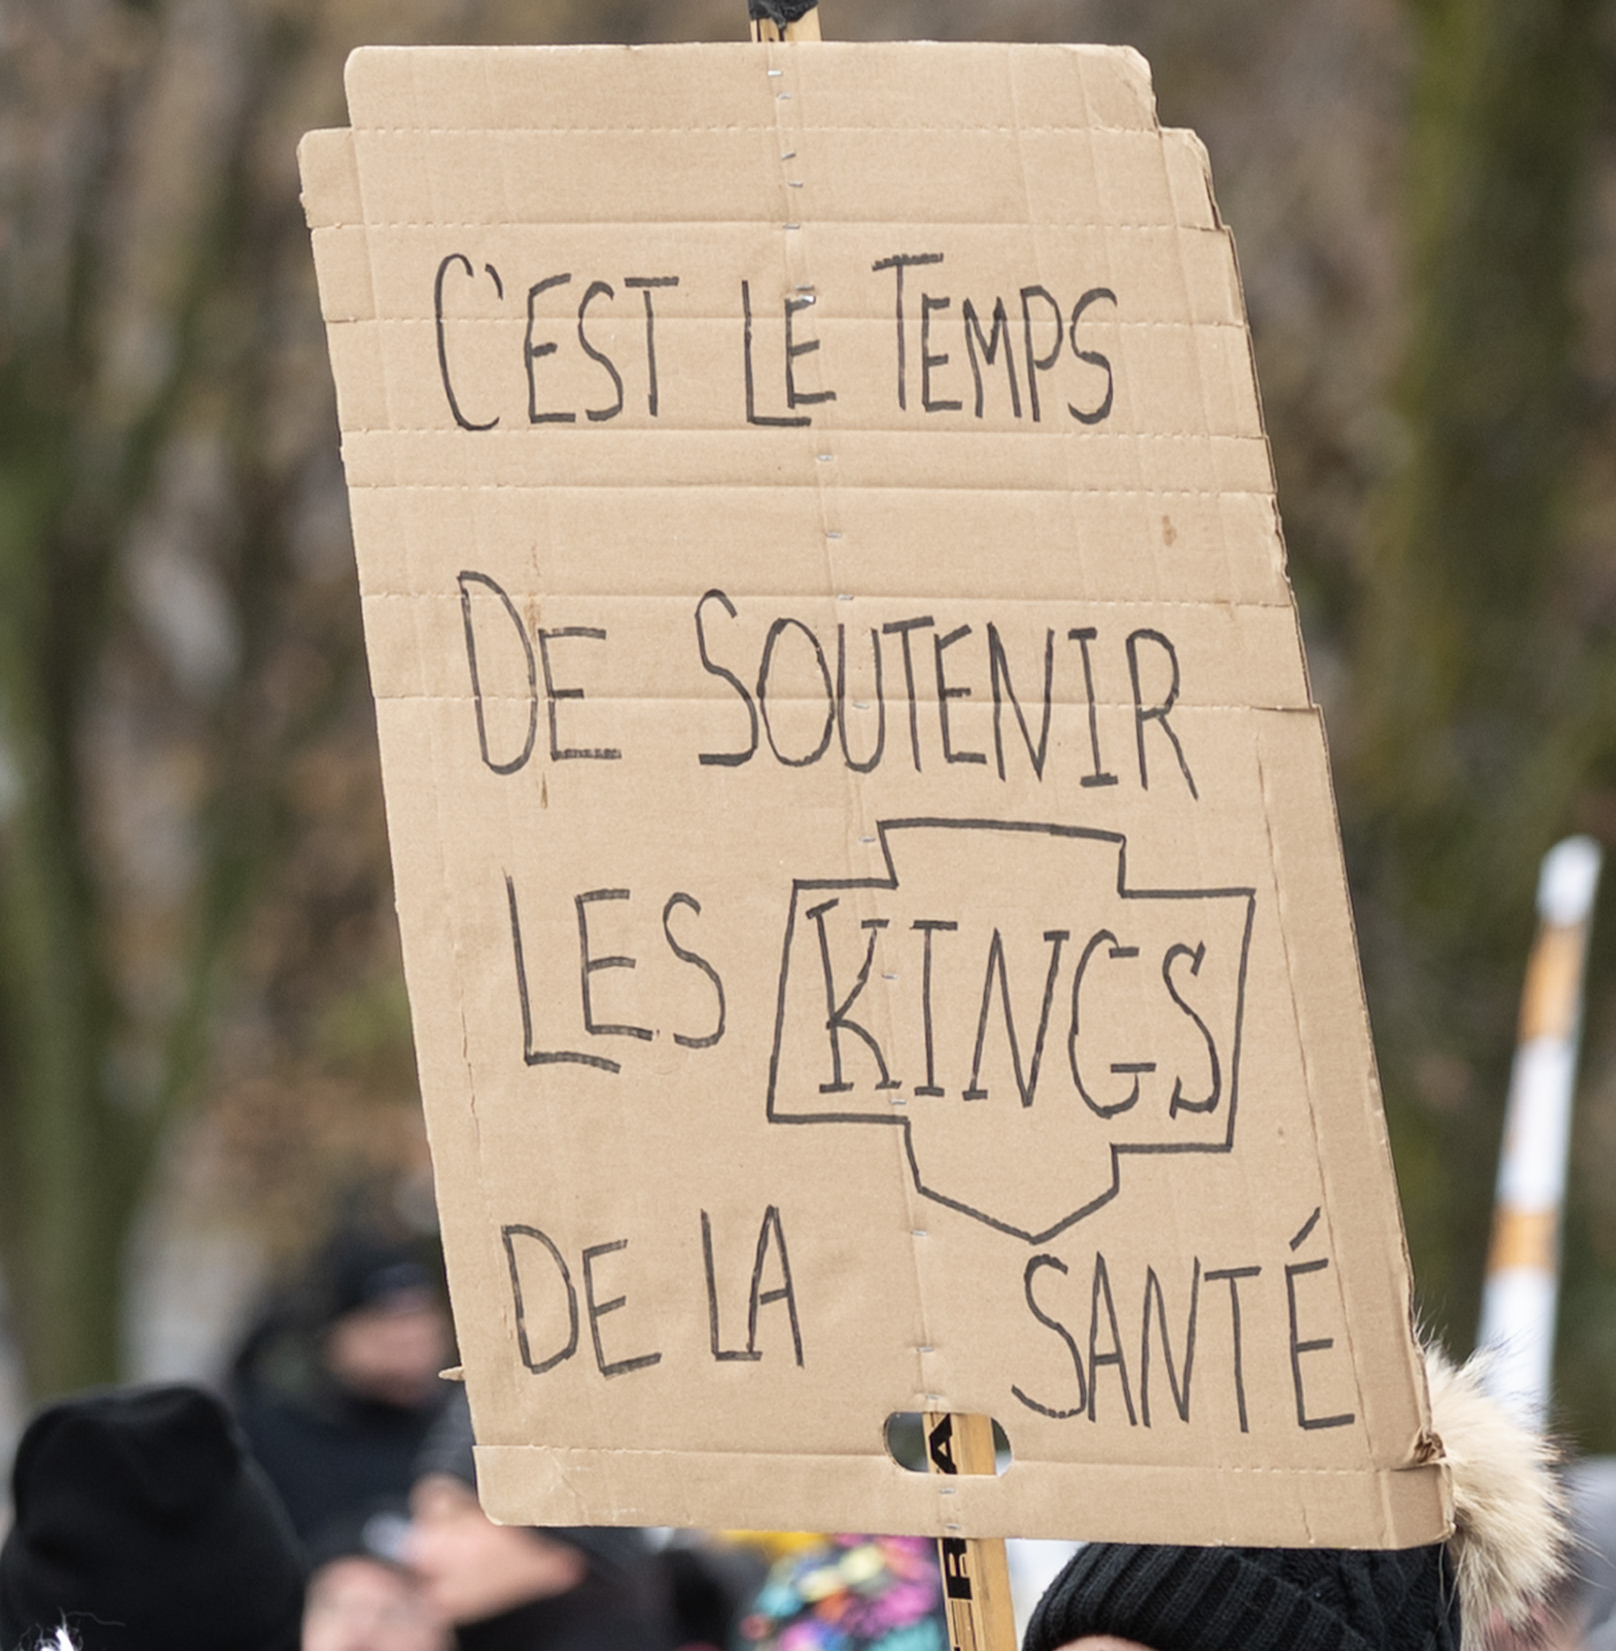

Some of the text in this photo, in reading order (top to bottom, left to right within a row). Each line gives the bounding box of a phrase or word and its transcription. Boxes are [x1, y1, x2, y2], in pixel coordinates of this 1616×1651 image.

[433, 252, 1119, 432] C'EST LE TEMPS
[459, 570, 1199, 800] DE SOUTENIR
[505, 869, 1225, 1120] LES KINGS
[502, 1205, 1355, 1433] DE LA SANTÉ
